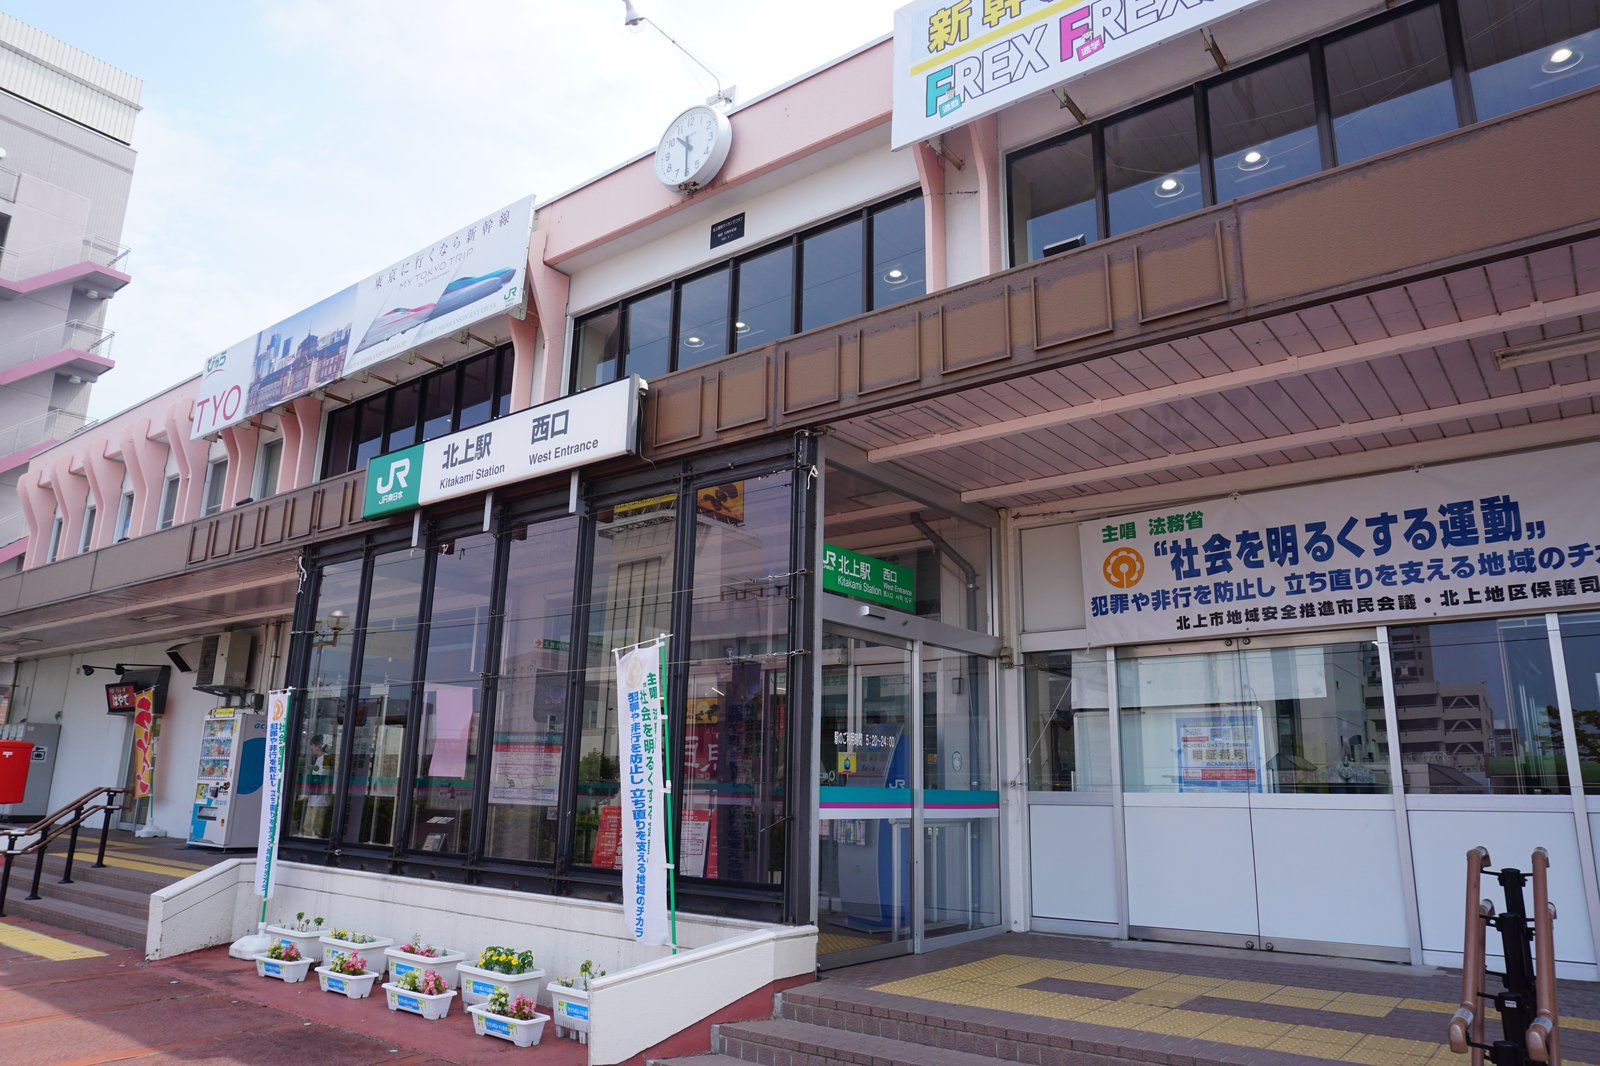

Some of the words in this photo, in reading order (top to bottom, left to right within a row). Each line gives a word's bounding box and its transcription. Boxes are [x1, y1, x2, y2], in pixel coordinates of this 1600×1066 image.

[926, 23, 1049, 118] FREX
[374, 209, 511, 290] 東京に行くなら新幹線
[415, 260, 447, 283] TOKYO
[449, 247, 475, 267] TRIP
[503, 286, 517, 300] JR
[197, 384, 242, 433] TYO
[442, 432, 493, 470] 北上駅
[530, 409, 570, 445] 西口
[377, 457, 411, 494] JR
[440, 473, 474, 490] Kitakami
[476, 462, 505, 480] Station
[529, 451, 551, 465] West
[554, 438, 599, 461] Entrance
[1102, 521, 1137, 543] 主唱
[1148, 510, 1204, 536] 法務省
[838, 555, 871, 581] 北上駅
[883, 567, 897, 583] 西口
[838, 575, 862, 591] Kitakami
[863, 582, 882, 596] Station
[1284, 542, 1600, 597] 立ち直りを支える地域のチ
